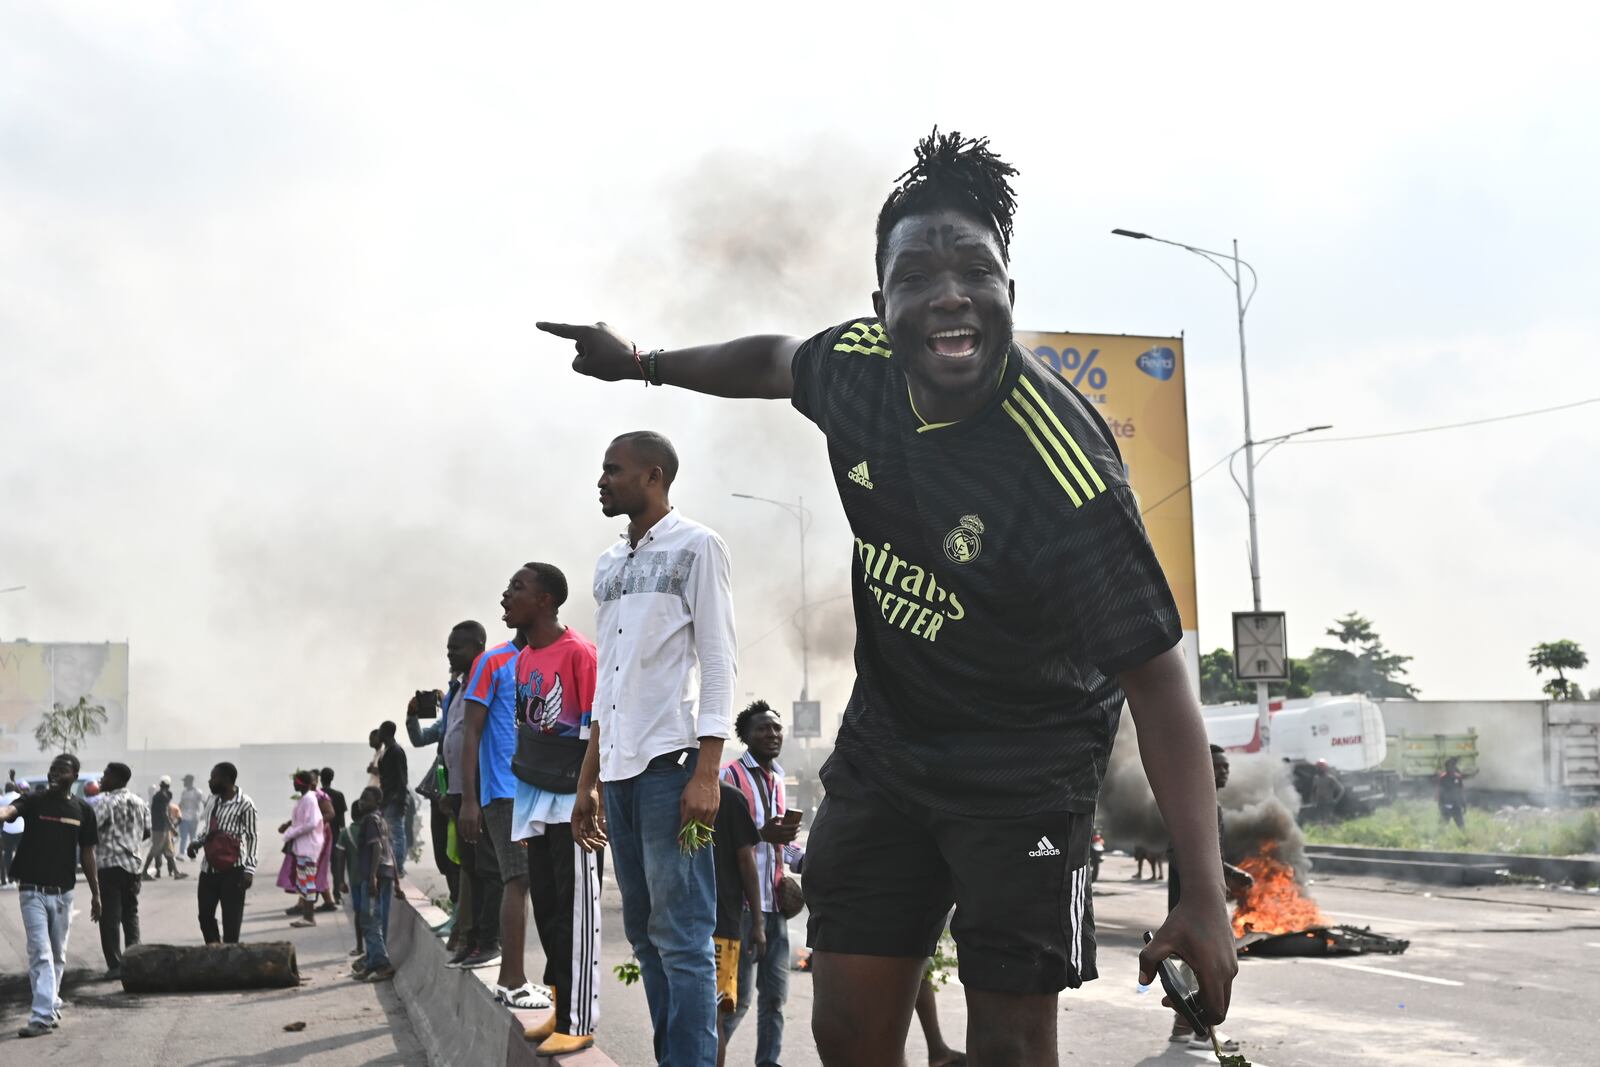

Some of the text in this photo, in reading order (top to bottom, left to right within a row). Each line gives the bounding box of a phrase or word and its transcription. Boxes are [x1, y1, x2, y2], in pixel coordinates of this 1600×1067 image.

[848, 471, 874, 490] adidas
[1331, 736, 1362, 747] DANGER
[1028, 848, 1060, 857] adidas
